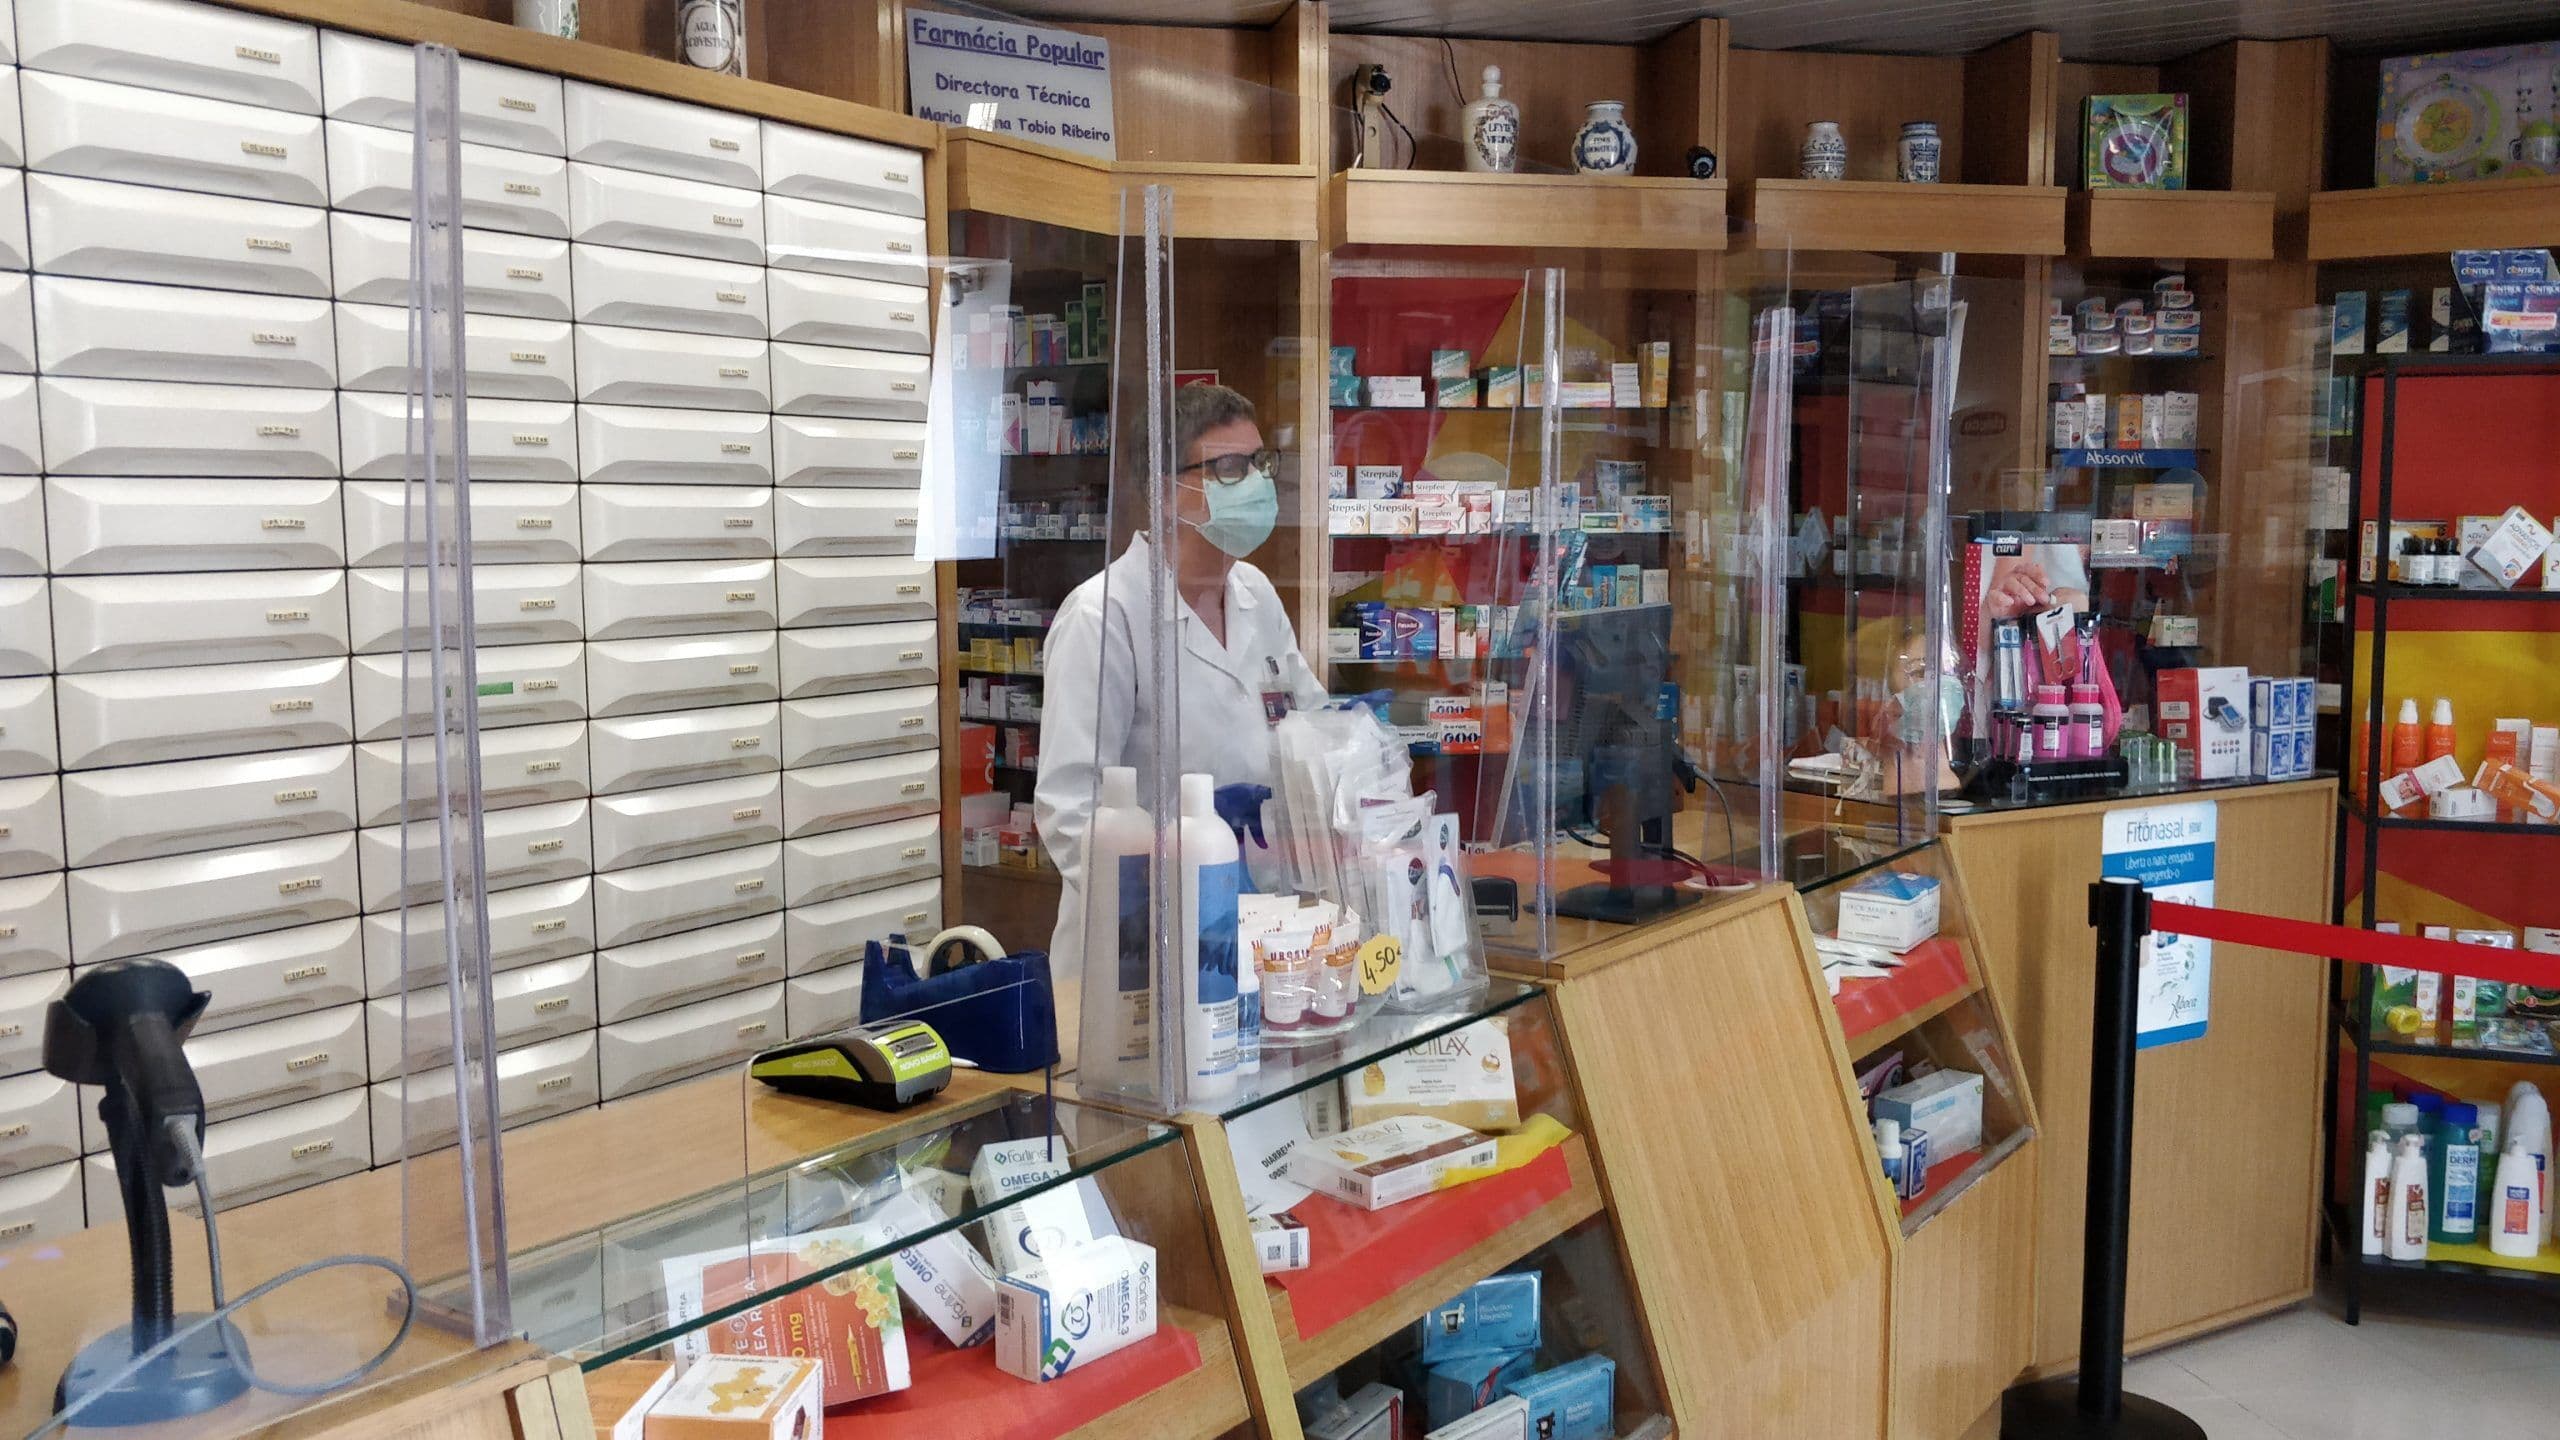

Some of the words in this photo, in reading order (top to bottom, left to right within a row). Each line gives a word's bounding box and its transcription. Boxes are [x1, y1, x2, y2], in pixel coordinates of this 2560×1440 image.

[913, 18, 1016, 53] Farmácia
[1027, 35, 1104, 65] Popular
[936, 72, 1019, 99] Directora
[1027, 85, 1090, 108] Técnica
[920, 106, 962, 124] Maria
[1062, 123, 1110, 142] Ribeiro
[2461, 267, 2495, 276] CONTROL
[2506, 266, 2542, 274] CONTROL
[2086, 452, 2145, 465] Absorvit
[1360, 469, 1398, 479] Strepsils
[1373, 503, 1411, 514] Strepsils
[1001, 1170, 1051, 1187] OMEGA
